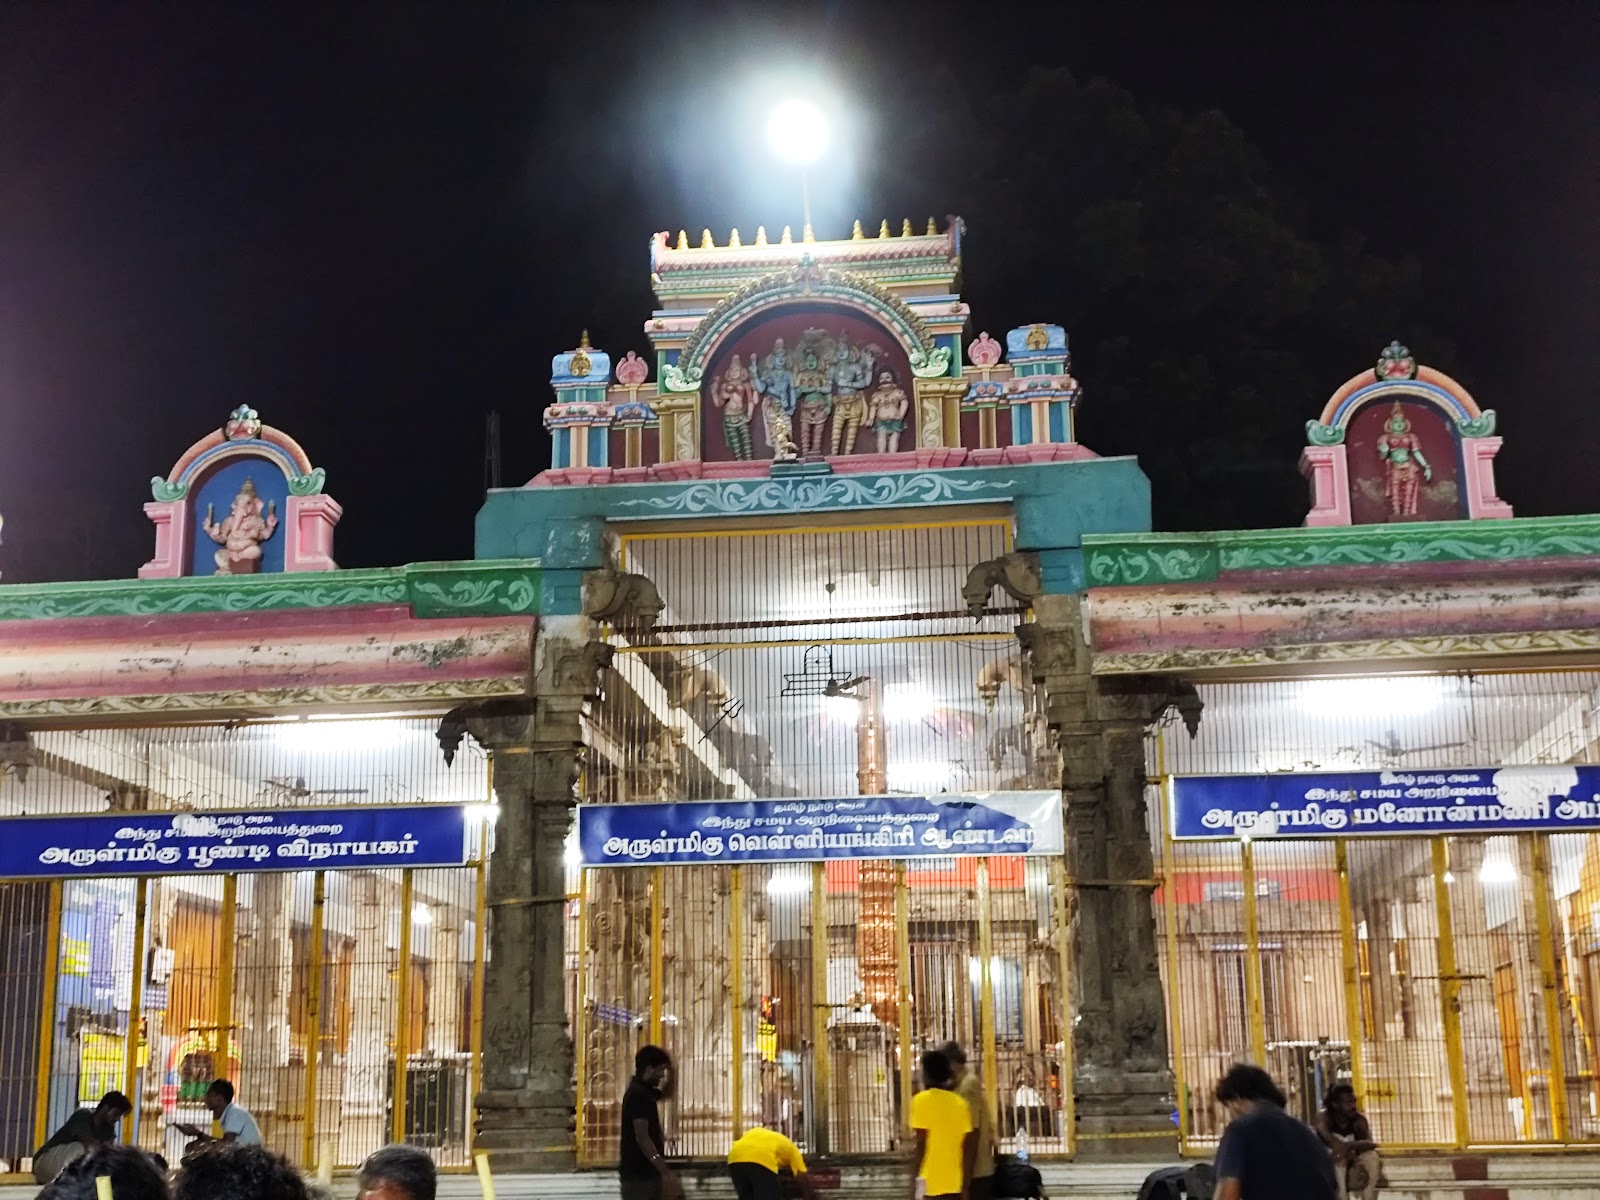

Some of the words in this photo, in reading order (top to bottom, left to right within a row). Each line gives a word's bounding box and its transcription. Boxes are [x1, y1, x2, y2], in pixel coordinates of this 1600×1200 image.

[1417, 773, 1446, 785] நாடு
[1447, 773, 1480, 784] அரசு
[1305, 787, 1358, 803] இந்து
[1360, 788, 1401, 799] சமய
[774, 801, 806, 814] தமிழ்
[807, 801, 834, 813] நாடு
[835, 801, 866, 811] அரசு
[217, 815, 243, 826] நாடு
[244, 815, 274, 825] அரசு
[702, 815, 751, 830] இந்து
[753, 815, 791, 827] சமய
[795, 811, 940, 828] அறநிலையத்துறை
[115, 827, 162, 841] இந்து
[602, 829, 724, 860] அருள்மிகு
[728, 824, 915, 852] வெள்ளியங்கிரி
[39, 841, 181, 867] அருள்மிகு
[187, 838, 271, 868] பூண்டி
[277, 833, 418, 862] விநாயகர்
